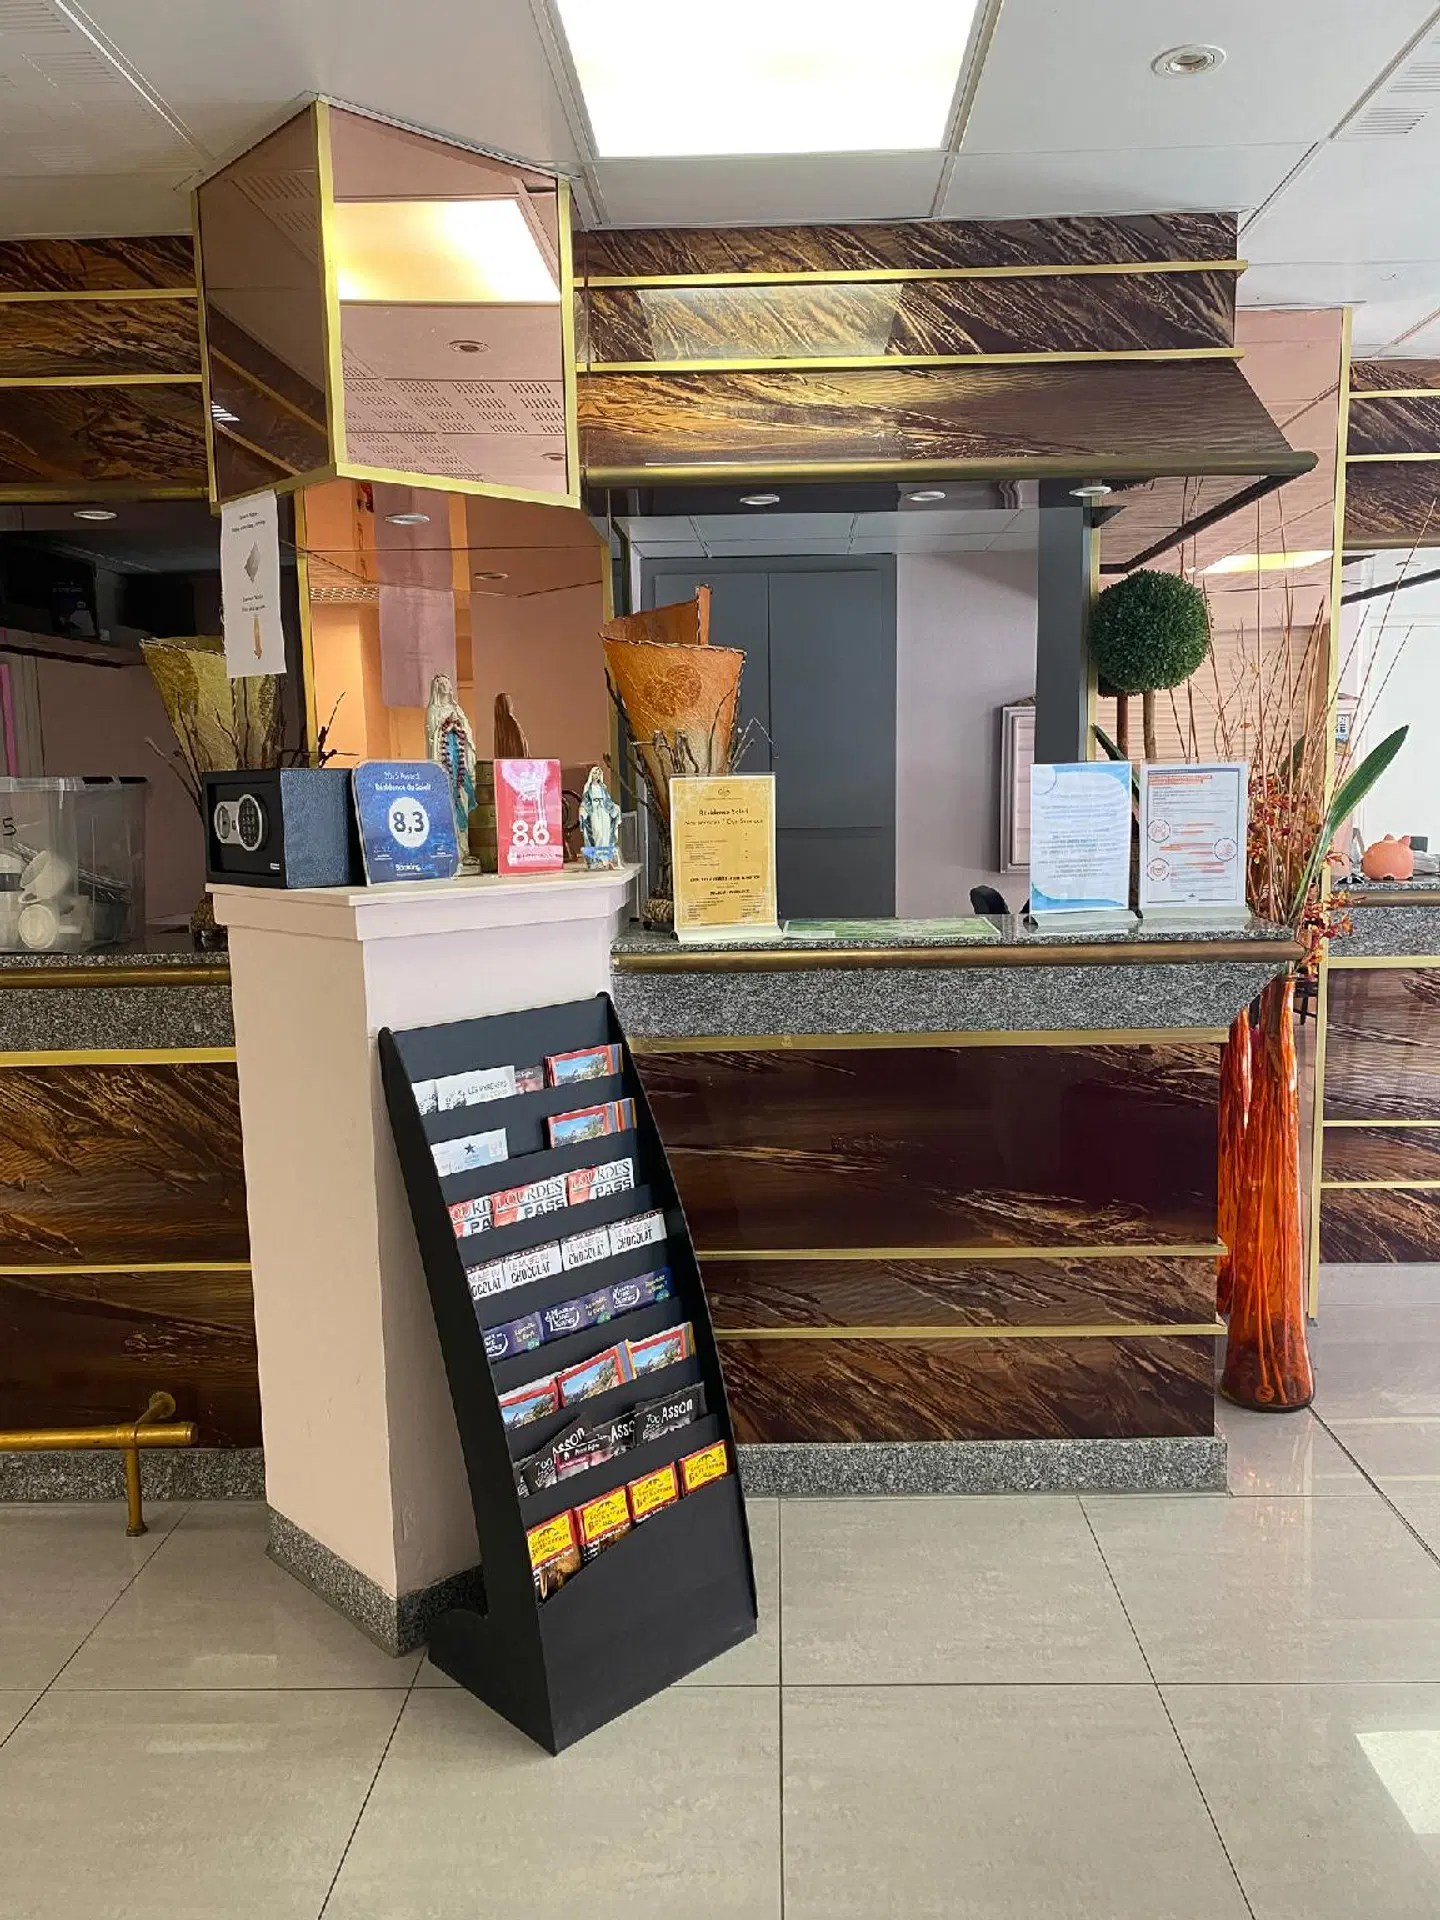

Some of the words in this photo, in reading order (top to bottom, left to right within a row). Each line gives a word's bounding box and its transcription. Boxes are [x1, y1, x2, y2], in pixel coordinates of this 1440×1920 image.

[2, 817, 18, 836] 5
[393, 811, 425, 834] 8,3
[571, 1161, 631, 1188] LOURDES
[496, 1179, 564, 1209] LOURDES
[595, 1178, 632, 1197] PASS
[523, 1199, 566, 1218] PASS
[617, 1229, 653, 1250] CHOCOLAT
[569, 1244, 604, 1265] CHOCOLAT
[511, 1261, 552, 1284] CHOCOLAT
